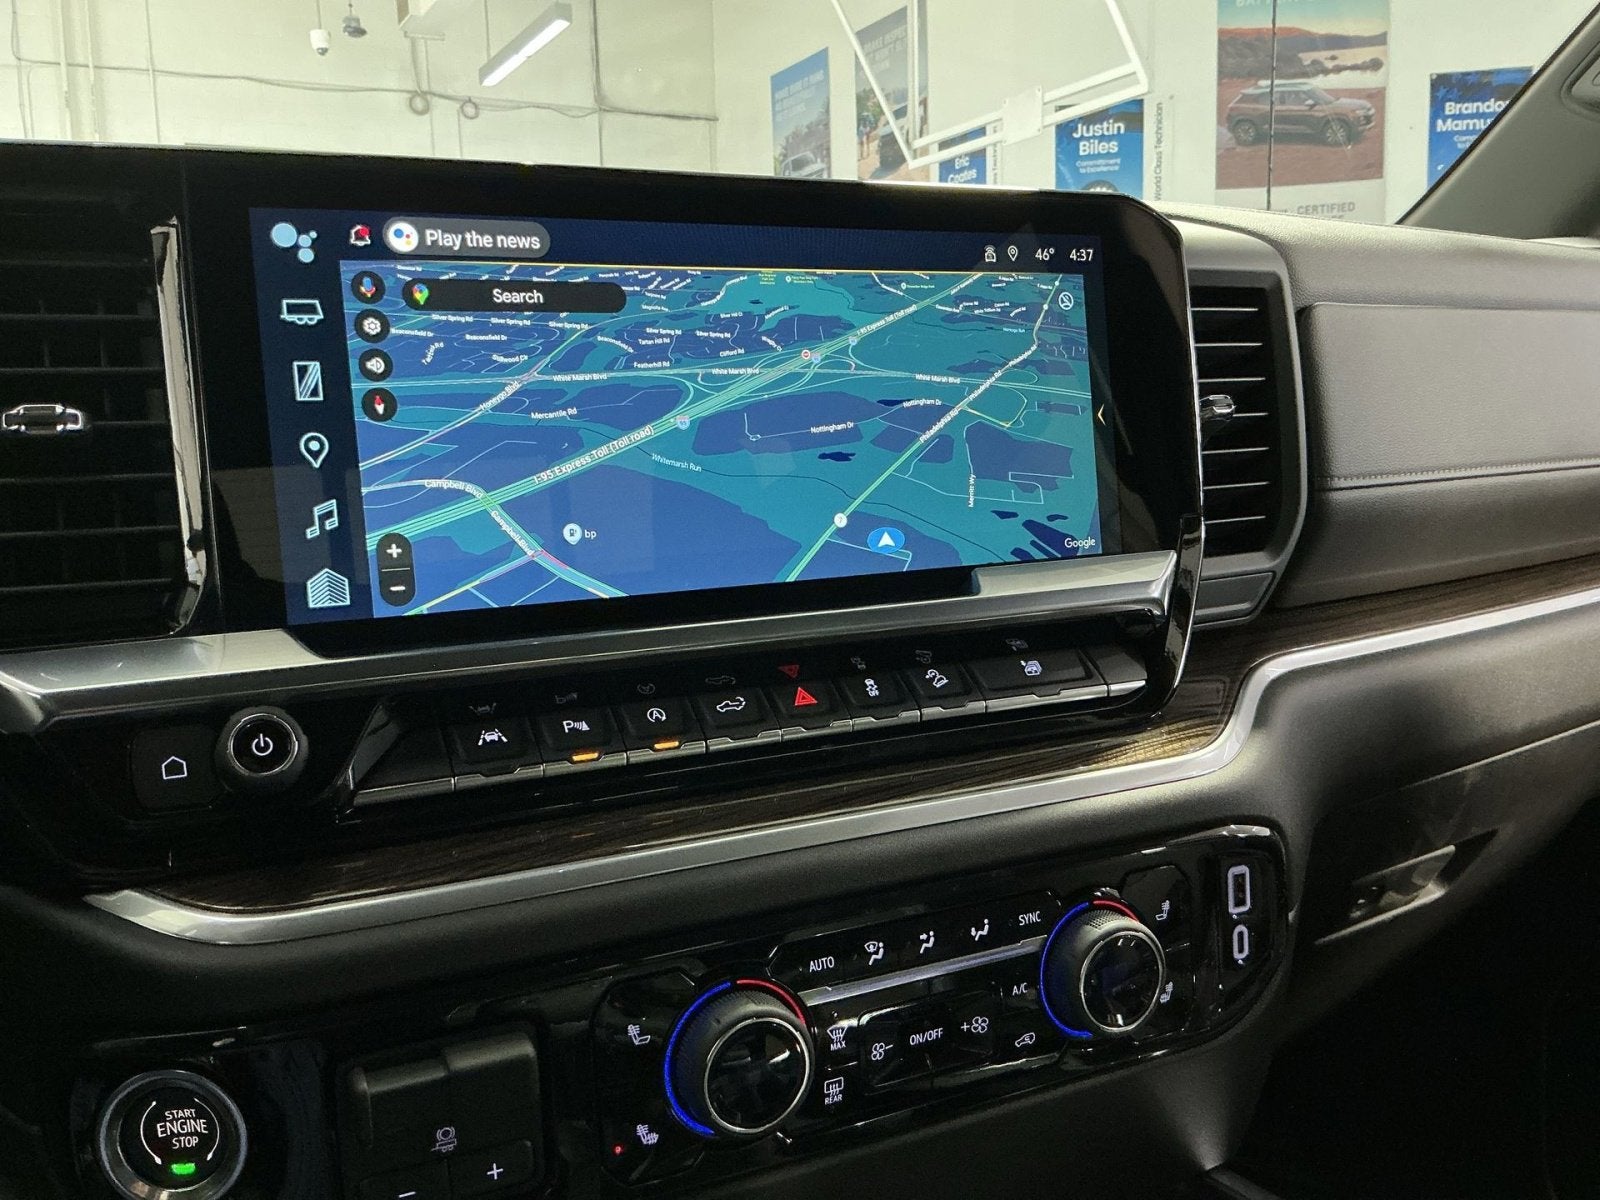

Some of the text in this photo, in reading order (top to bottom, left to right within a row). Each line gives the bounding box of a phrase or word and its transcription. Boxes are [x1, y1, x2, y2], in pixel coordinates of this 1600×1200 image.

[1072, 119, 1125, 138] Justin
[1079, 139, 1119, 156] Biles
[1154, 102, 1163, 201] World Class Technician
[1297, 201, 1356, 215] CERTIFIED
[425, 229, 541, 250] Play the news
[1035, 247, 1055, 261] 46°
[1070, 249, 1093, 261] 4:37
[492, 288, 544, 304] Search
[448, 315, 465, 323] Spring
[597, 335, 629, 350] Beaconsfield
[553, 373, 607, 382] White Marsh Blvd
[931, 375, 948, 383] Marsh
[948, 376, 960, 384] Blvd
[504, 380, 520, 393] Blvd
[968, 370, 1002, 401] Philadelphia Rd
[903, 399, 935, 408] Nottingham
[531, 407, 578, 420] Mercantile Rd
[810, 421, 854, 434] Nottingham Dr
[919, 409, 960, 443] Philadelphia Rd
[534, 425, 655, 484] I-95 Express Toll (Toll road)
[651, 453, 702, 472] Whitemarsh Run
[968, 474, 977, 485] Wy
[424, 479, 484, 499] Campbell Blvd
[490, 510, 536, 556] Campbell Blvd
[584, 529, 597, 540] bp
[1064, 537, 1096, 549] Google
[1018, 911, 1041, 926] SYNC
[809, 956, 835, 973] AUTO
[1012, 983, 1028, 996] A/C
[909, 1027, 944, 1046] ON/OFF
[830, 1041, 846, 1051] MAX
[824, 1094, 843, 1105] REAR
[165, 1108, 197, 1121] START
[156, 1119, 209, 1138] ENGINE
[172, 1136, 199, 1150] STOP
